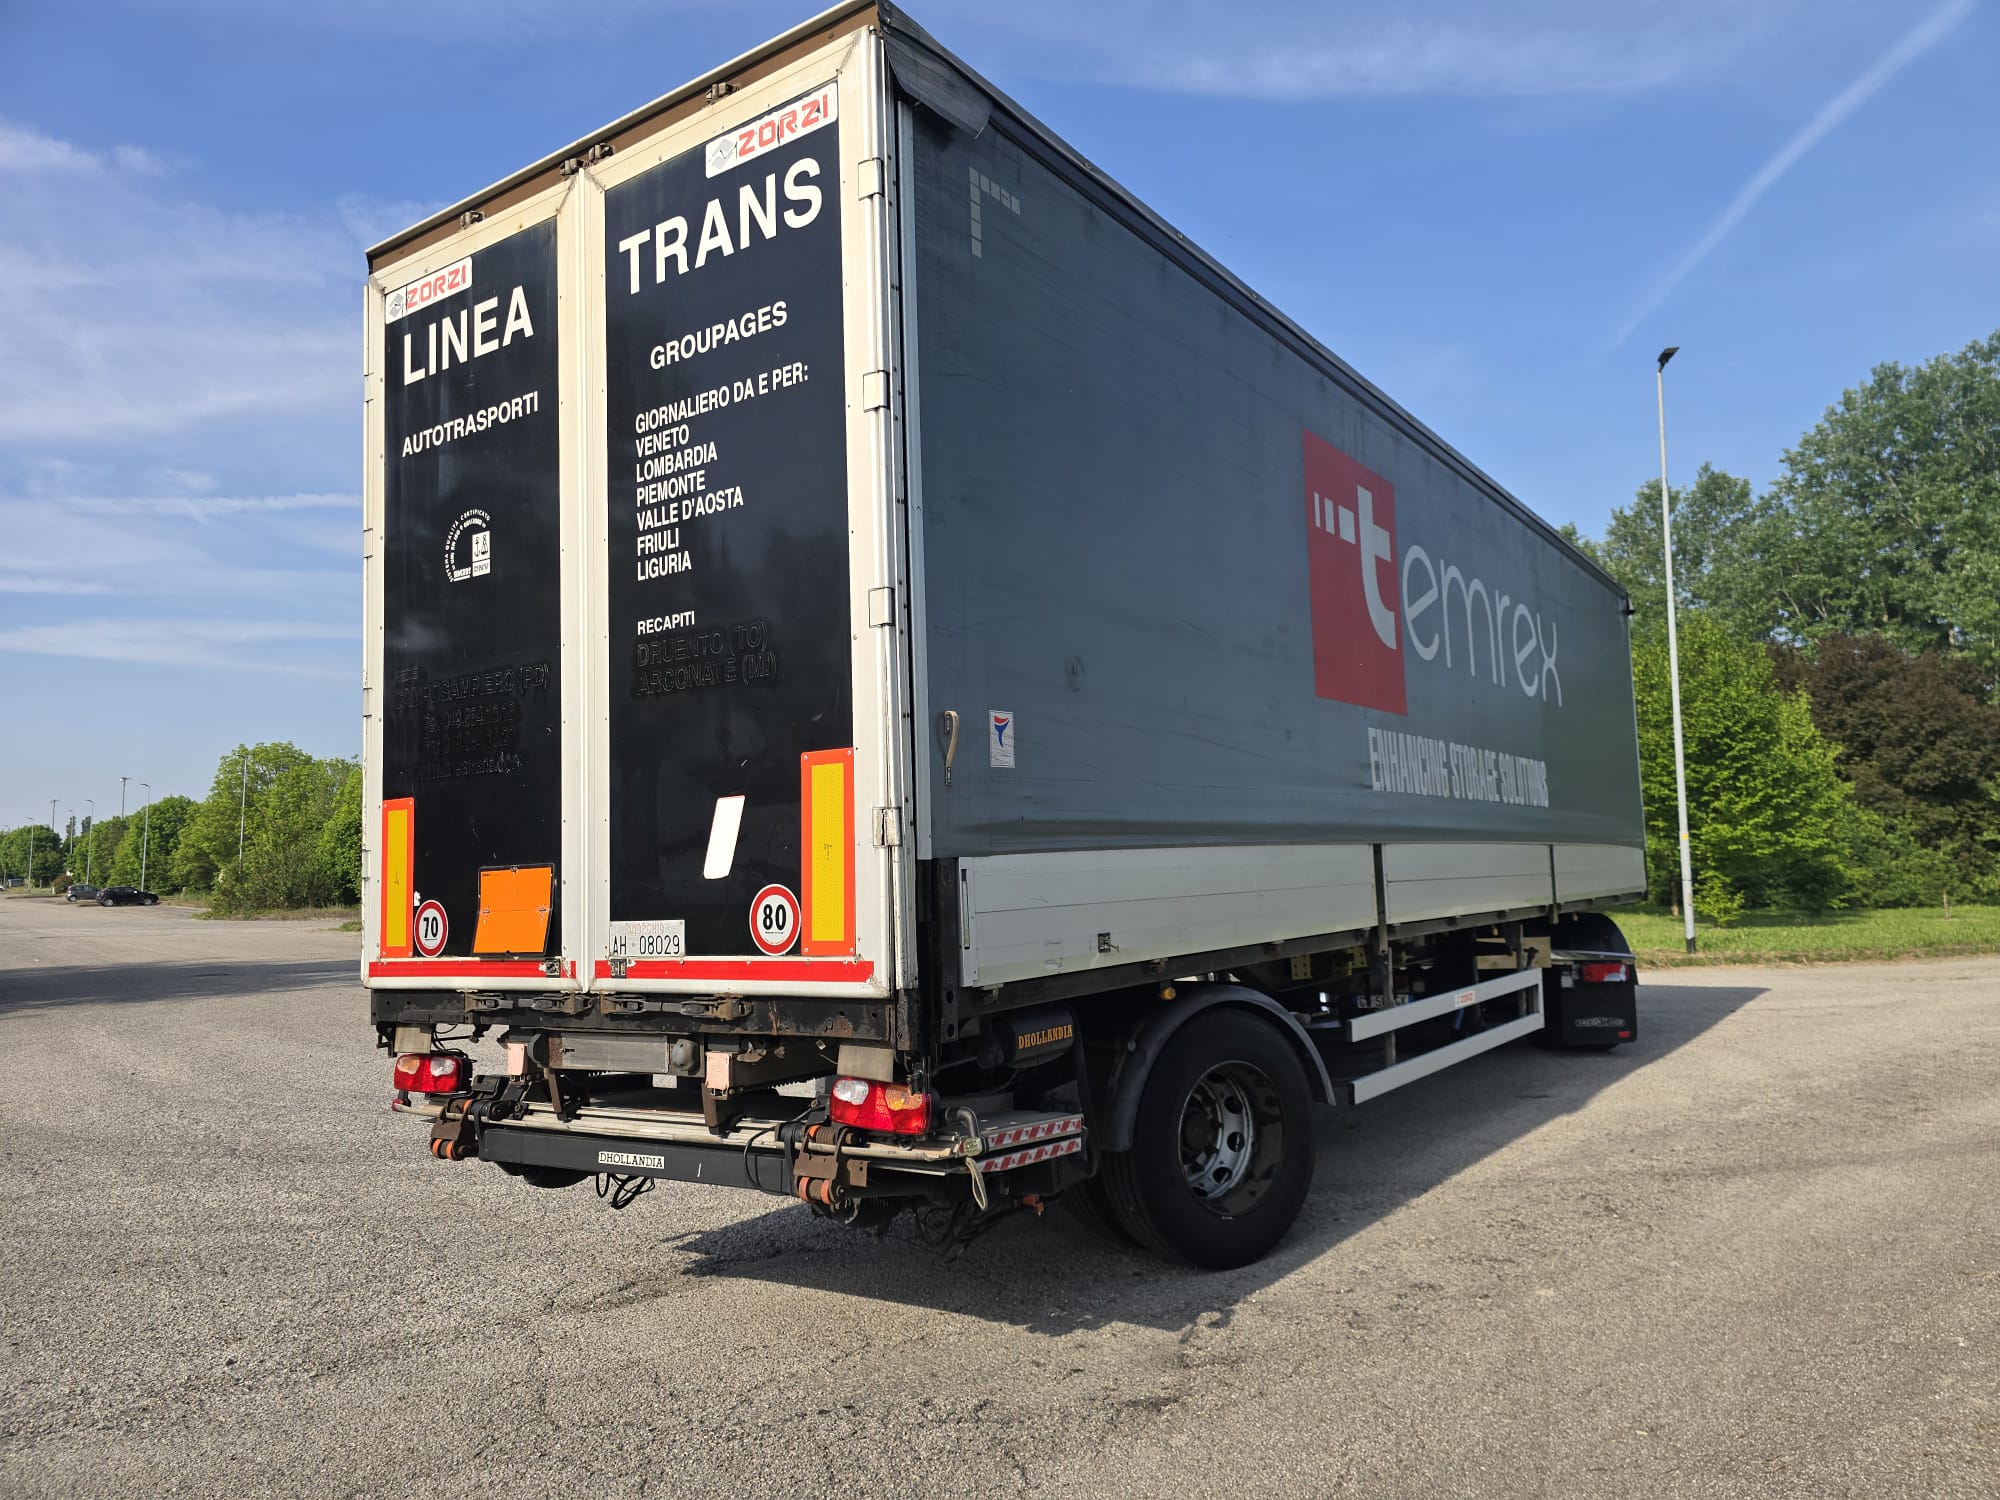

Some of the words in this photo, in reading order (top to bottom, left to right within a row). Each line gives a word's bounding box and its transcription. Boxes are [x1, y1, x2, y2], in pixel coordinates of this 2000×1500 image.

[737, 93, 829, 158] ZORZI
[619, 157, 823, 295] TRANS
[406, 264, 467, 310] ZORZI
[403, 285, 534, 385] LINEA
[650, 301, 788, 370] GROUPAGES
[635, 385, 729, 432] GIORNALIERO
[734, 380, 755, 404] DA
[758, 374, 769, 395] E
[773, 363, 808, 391] PER:
[402, 391, 538, 458] AUTOTRASPORTI
[636, 425, 689, 457] VENETO
[636, 442, 717, 483] LOMBARDIA
[636, 471, 705, 507] PIEMONTE
[637, 506, 678, 531] VALLE
[683, 486, 744, 521] D'AOSTA
[637, 528, 680, 556] FRIULI
[474, 563, 488, 573] DNV
[637, 550, 692, 581] LIGURIA
[1357, 485, 1562, 707] temrex
[637, 611, 695, 635] RECAPITI
[1368, 727, 1447, 797] ENHANCING
[1449, 741, 1497, 802] STORAGE
[1499, 753, 1549, 808] SOLUTIONS
[423, 916, 439, 939] 70
[763, 903, 787, 931] 80
[613, 935, 627, 955] AH
[639, 934, 680, 955] 08029
[1018, 1024, 1073, 1049] DHOLLANDIA
[598, 1152, 664, 1169] DHOLLANDIA
